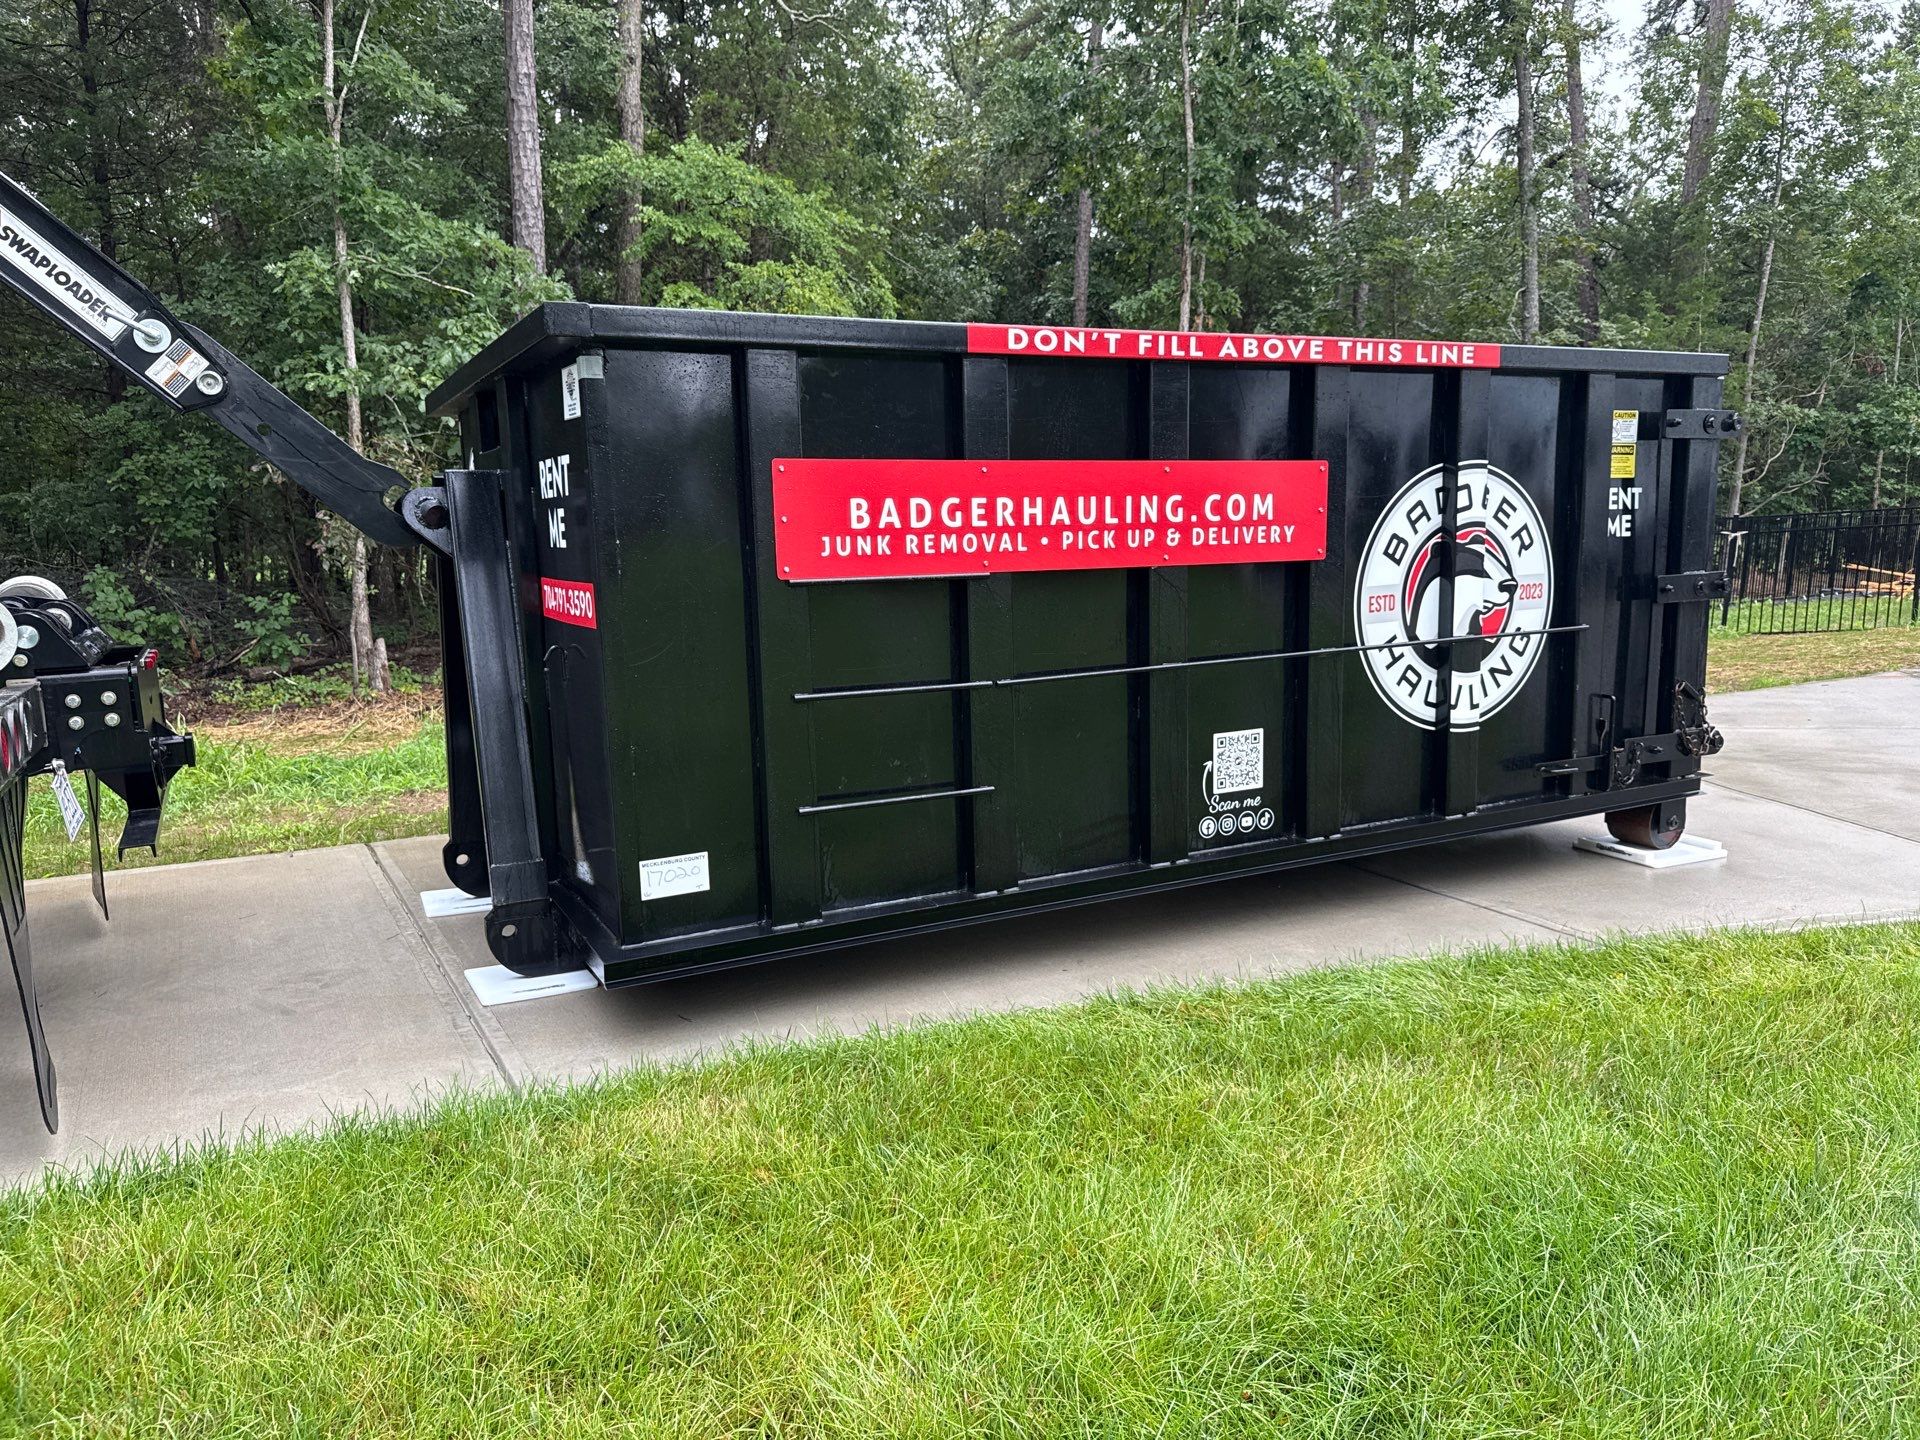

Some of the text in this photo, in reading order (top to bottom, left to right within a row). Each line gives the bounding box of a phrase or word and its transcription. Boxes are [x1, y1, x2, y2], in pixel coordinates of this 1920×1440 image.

[1007, 328, 1475, 364] DON'T FILL ABOVE THIS LINE
[538, 454, 570, 499] RENT
[849, 493, 1274, 530] BADGERHAULING.COM
[548, 507, 567, 548] ME
[1607, 514, 1632, 537] ME
[820, 525, 1296, 557] JUNK REMOVAL PICK UP & DELIVERY
[1368, 594, 1396, 613] ESTD
[1519, 583, 1543, 601] 2023
[1379, 626, 1530, 711] HAULING
[1208, 794, 1262, 813] Scan me
[642, 858, 683, 868] MECKLENBURG
[647, 865, 701, 887] 17020
